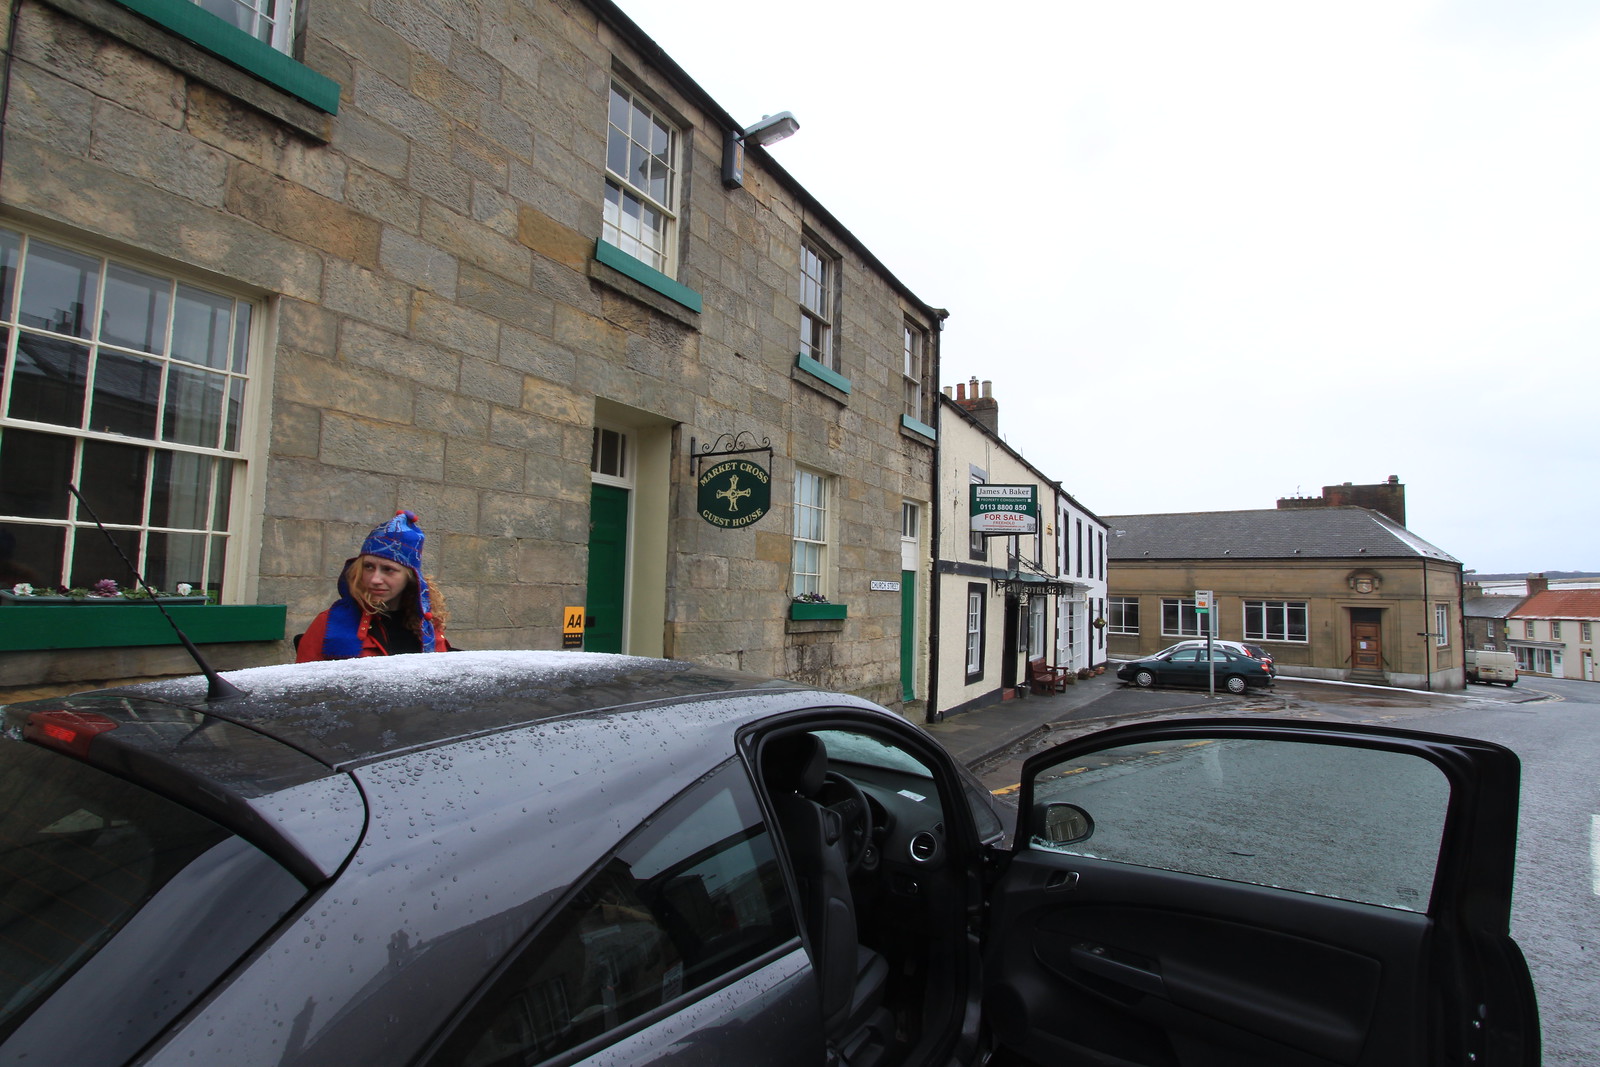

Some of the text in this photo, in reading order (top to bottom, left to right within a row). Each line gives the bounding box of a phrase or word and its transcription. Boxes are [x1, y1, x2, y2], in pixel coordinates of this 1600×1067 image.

[699, 462, 769, 487] MARKET CROSS
[702, 507, 764, 527] GUEST HOUSE
[872, 581, 899, 590] CHURCH STREET
[566, 614, 582, 628] AA
